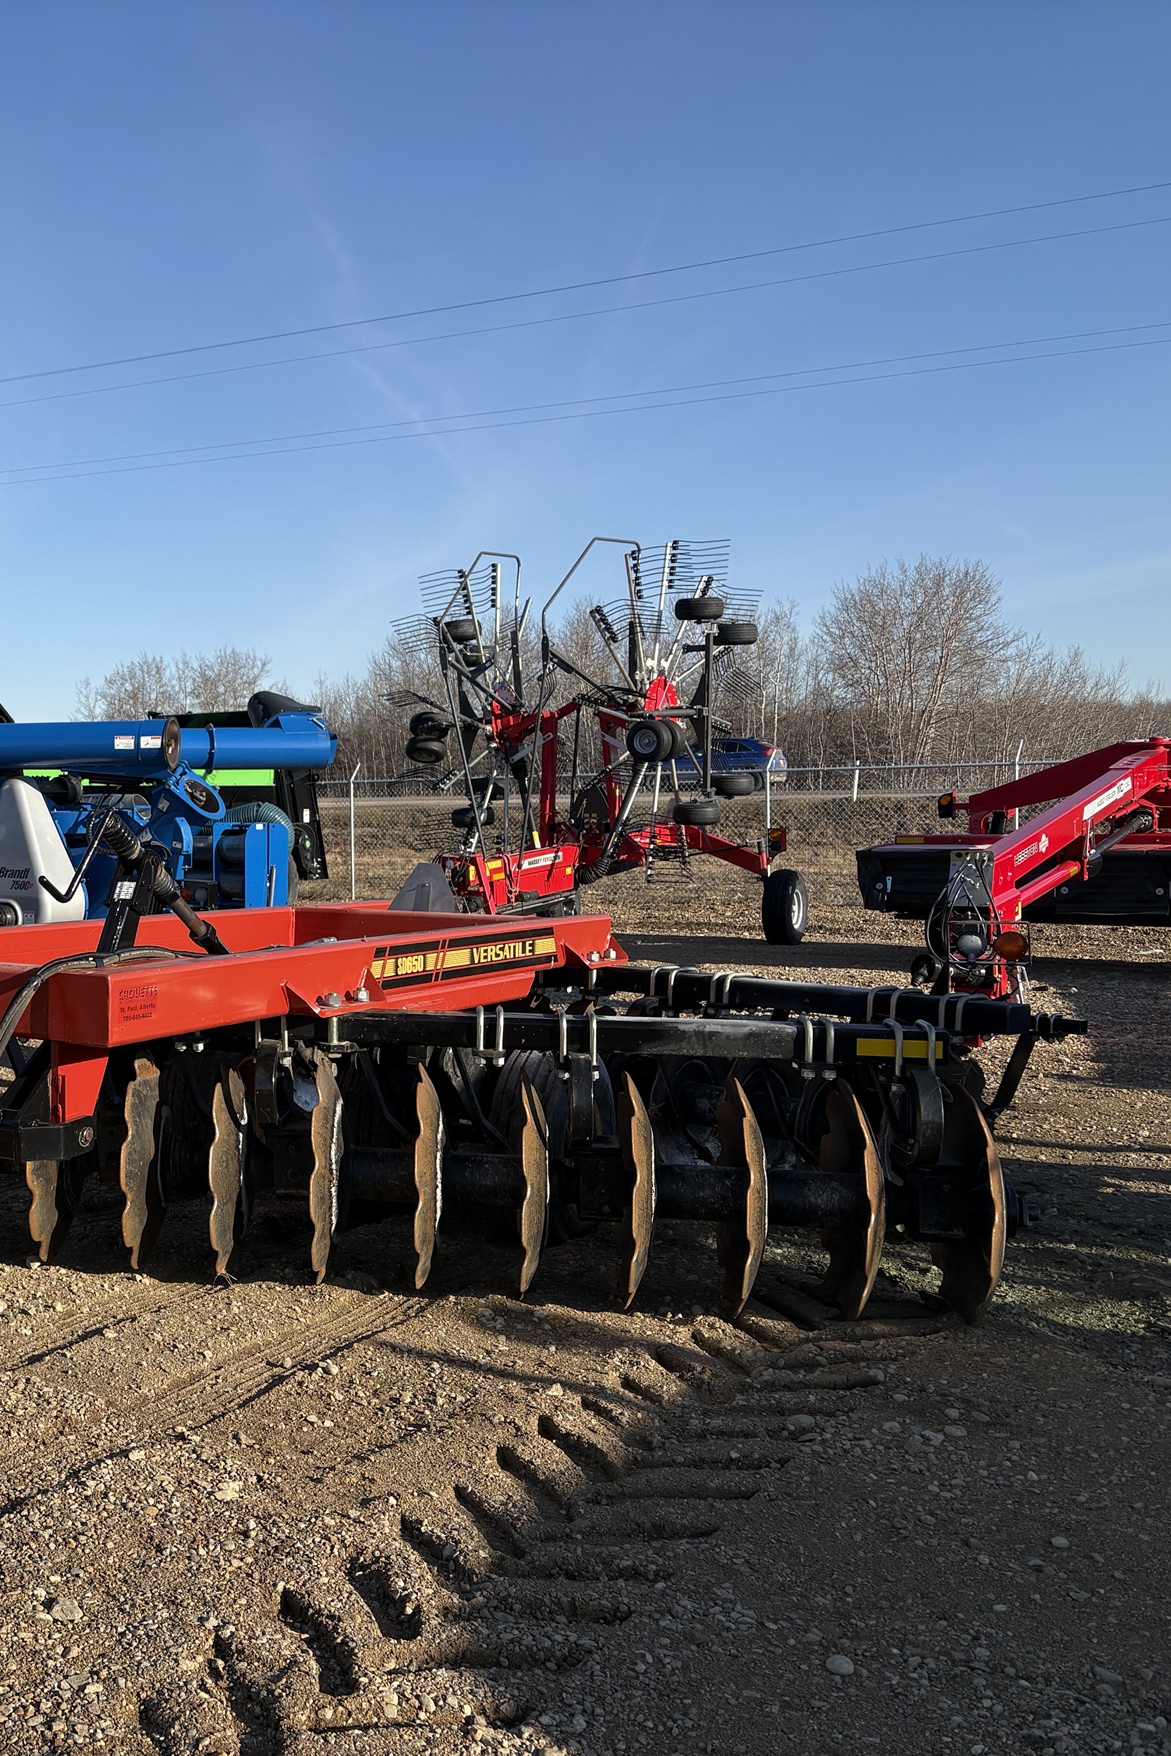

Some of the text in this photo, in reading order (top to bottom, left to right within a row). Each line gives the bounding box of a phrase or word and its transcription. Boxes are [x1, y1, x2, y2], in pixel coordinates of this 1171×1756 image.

[527, 857, 543, 867] MASSEY
[1014, 841, 1038, 867] HESSTON
[10, 880, 30, 890] 7500
[397, 940, 534, 975] SD650 VERSATILE
